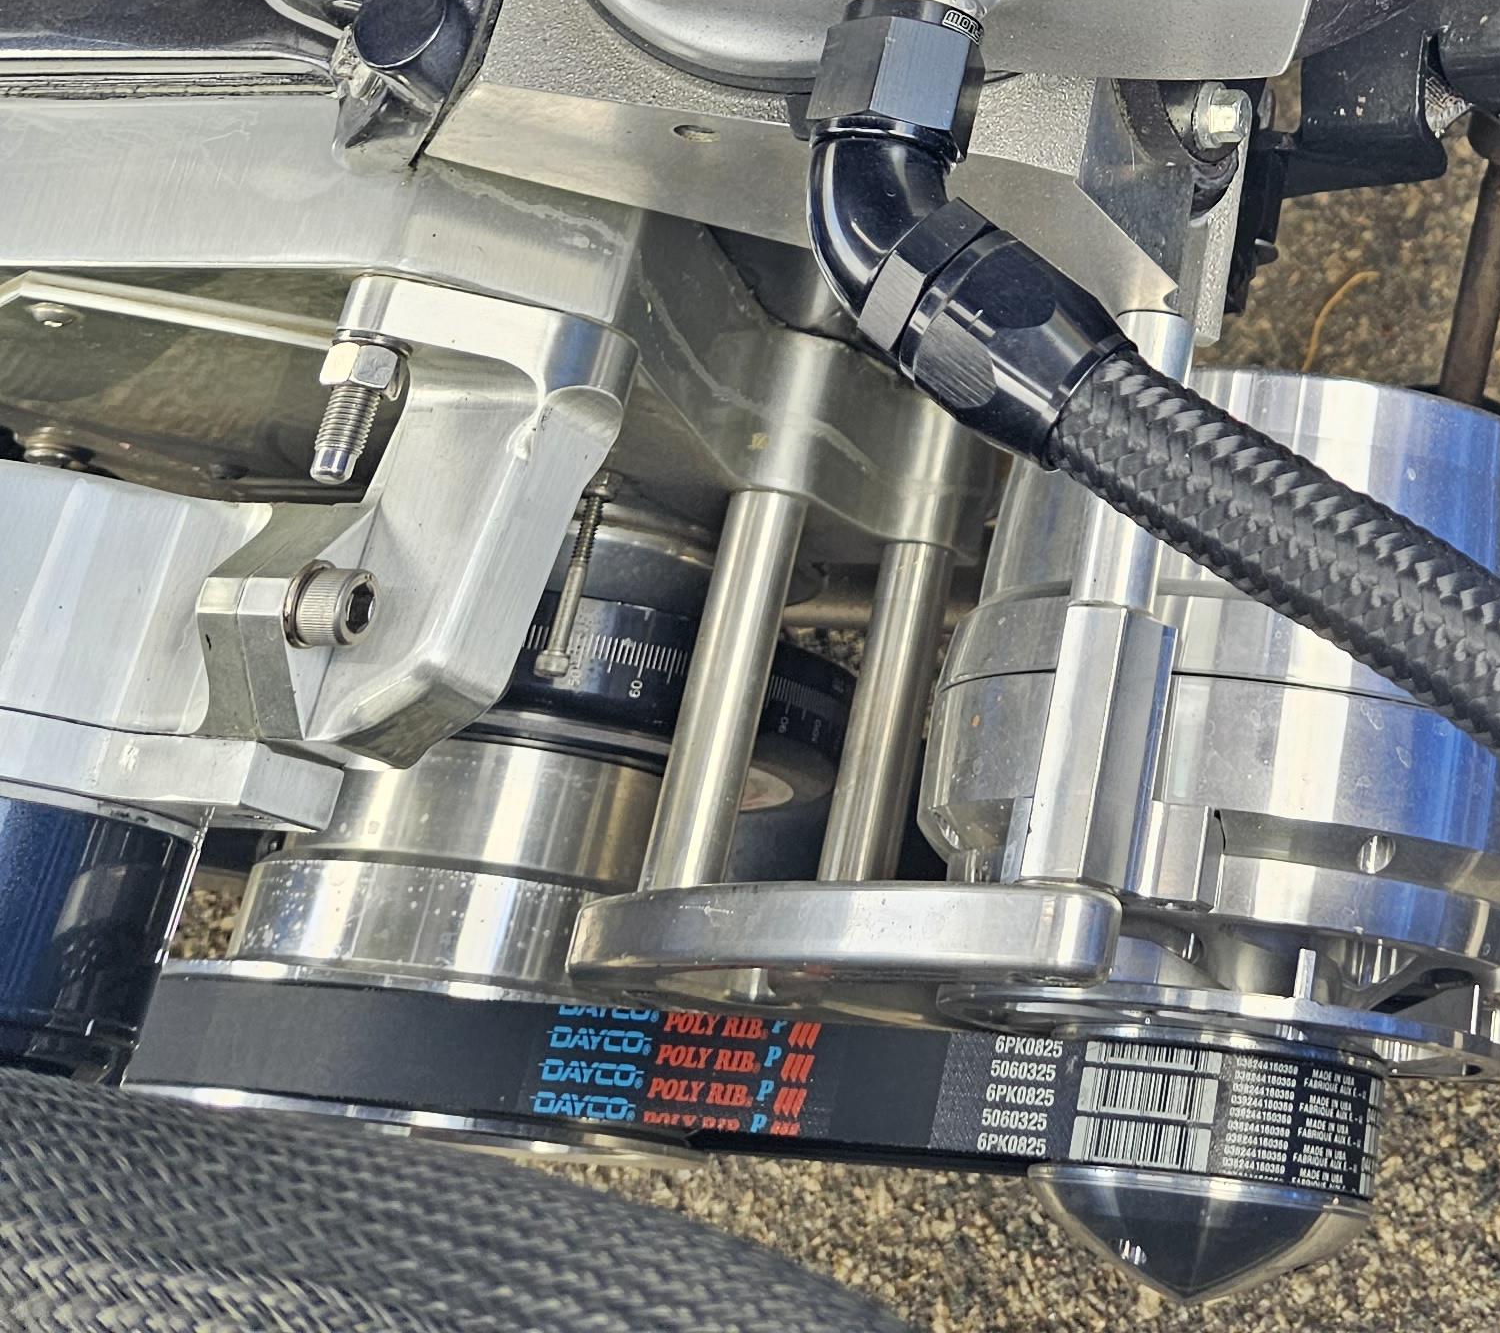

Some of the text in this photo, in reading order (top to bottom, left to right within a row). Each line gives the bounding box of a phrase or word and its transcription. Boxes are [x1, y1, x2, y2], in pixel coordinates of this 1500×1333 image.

[629, 679, 643, 699] 60
[663, 1012, 722, 1036] POLY
[547, 1025, 651, 1054] DAYCO
[655, 1044, 713, 1069] POLY
[995, 1035, 1064, 1058] 6PK0825
[539, 1058, 644, 1087] DAYCO
[646, 1077, 706, 1102] POLY
[991, 1059, 1057, 1082] 5060325
[1312, 1069, 1332, 1082] MADE
[531, 1091, 635, 1120] DAYCO
[986, 1083, 1055, 1107] 6PK0825
[1309, 1094, 1329, 1107] MADE
[981, 1108, 1048, 1131] 5060325
[1306, 1117, 1326, 1131] MADE
[976, 1132, 1047, 1157] 6PK0825
[1303, 1144, 1324, 1157] MADE
[1300, 1167, 1320, 1180] MADE
